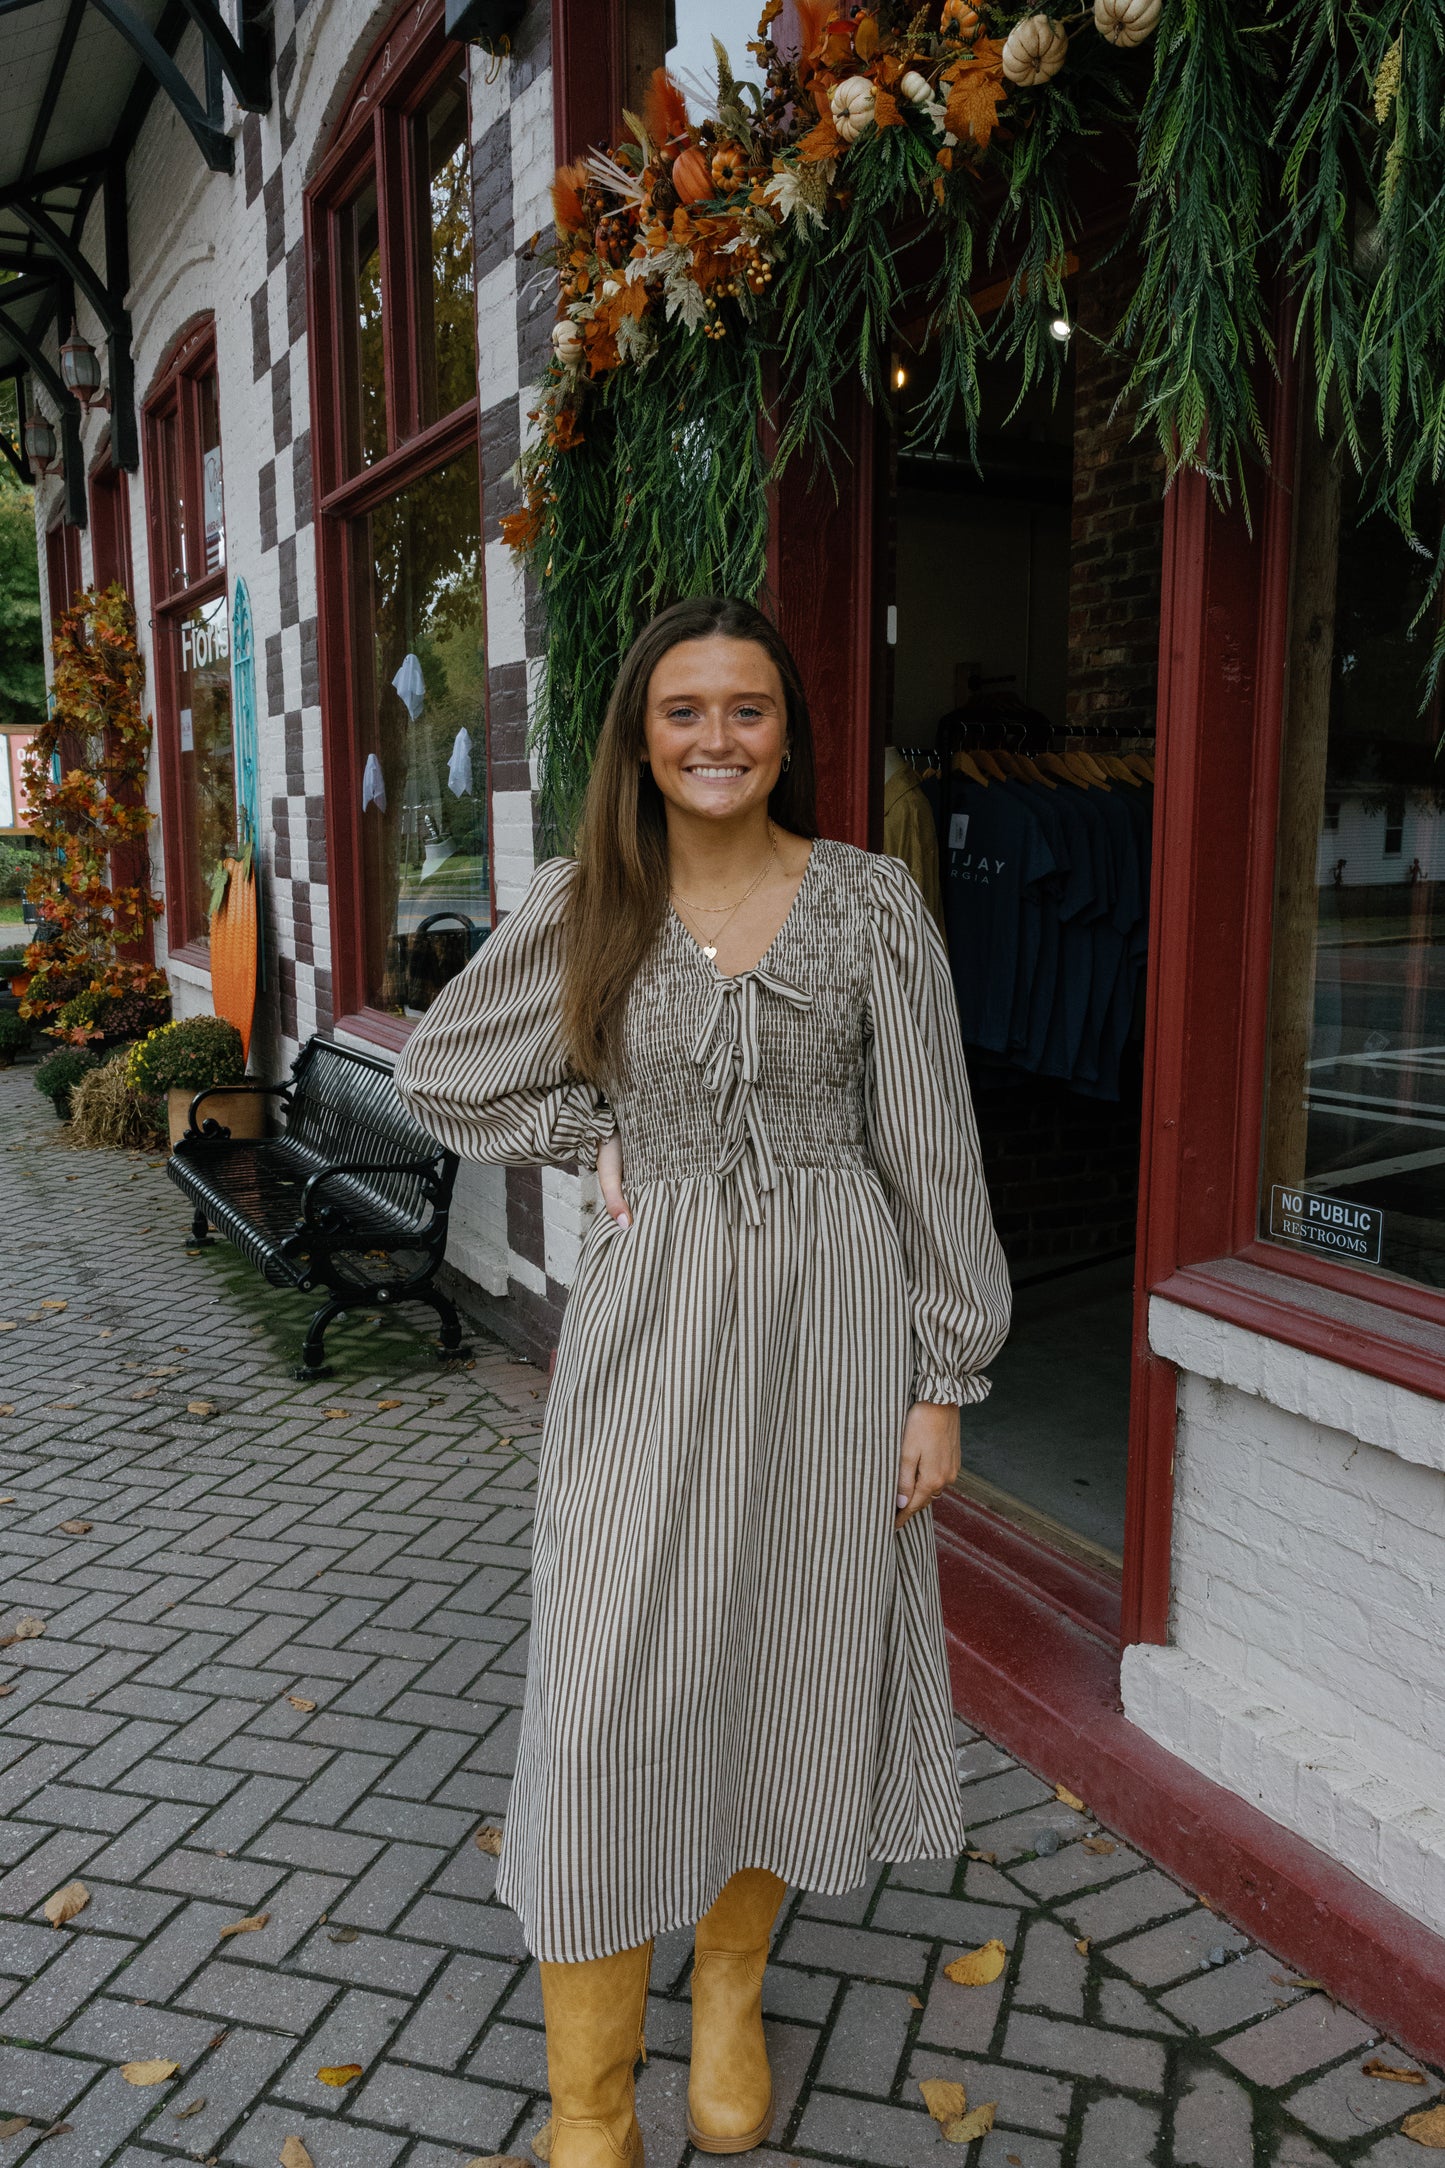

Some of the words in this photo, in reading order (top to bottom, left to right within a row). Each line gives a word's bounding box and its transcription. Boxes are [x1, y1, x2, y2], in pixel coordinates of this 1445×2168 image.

[950, 868, 989, 885] RGIA
[951, 850, 1006, 874] IJAY
[1281, 1192, 1303, 1214] NO
[1309, 1199, 1371, 1231] PUBLIC
[1282, 1219, 1368, 1254] RESTROOMS
